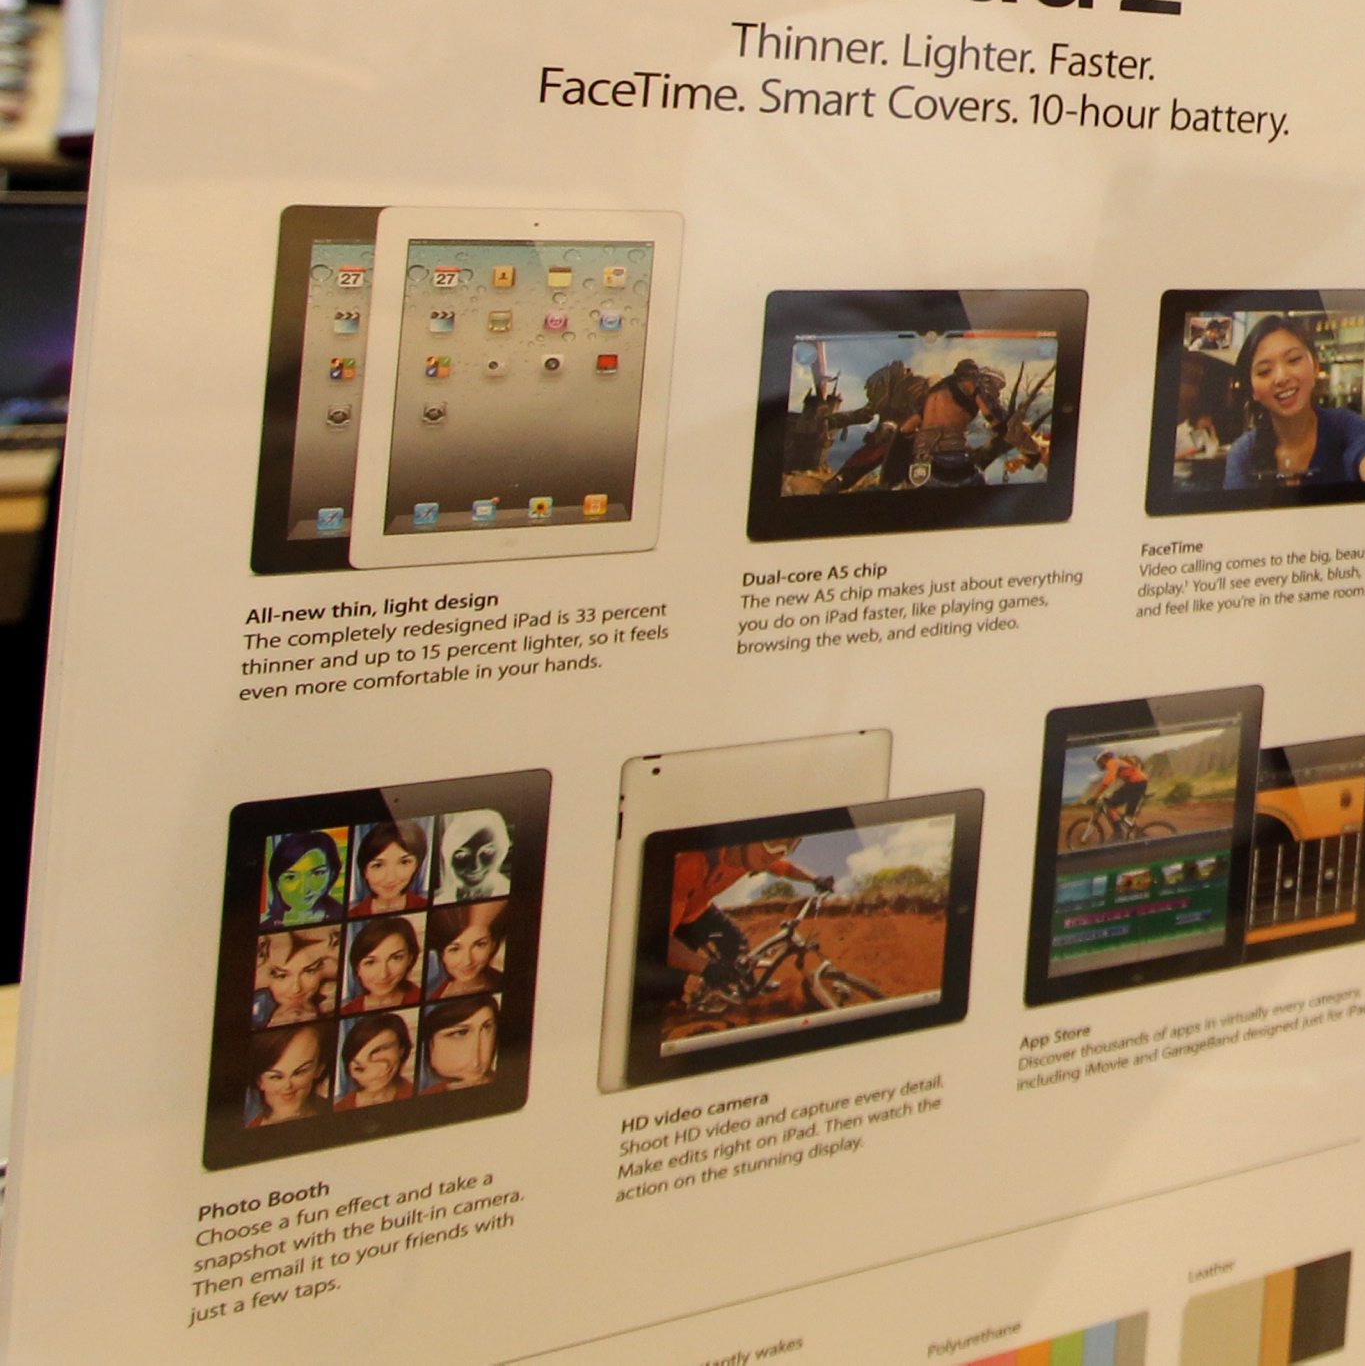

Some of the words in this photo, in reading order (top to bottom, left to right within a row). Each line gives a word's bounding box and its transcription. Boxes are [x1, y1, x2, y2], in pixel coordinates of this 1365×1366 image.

[731, 21, 888, 66] Thinner.
[903, 33, 1036, 79] Lighter.
[1049, 42, 1155, 81] Faster.
[539, 66, 745, 113] FaceTime.
[759, 78, 876, 118] Smart
[888, 85, 1018, 124] Covers.
[1029, 93, 1161, 130] 10-hour
[1170, 97, 1289, 144] battery.
[339, 272, 362, 286] 27
[435, 272, 457, 286] 27
[1139, 561, 1178, 578] Video
[1180, 558, 1223, 575] calling
[1225, 557, 1266, 571] comes
[1270, 555, 1284, 567] to
[1286, 551, 1307, 565] the
[1309, 549, 1332, 566] big,
[1140, 540, 1204, 557] FaceTime
[740, 593, 771, 610] The
[775, 593, 810, 607] new
[813, 588, 835, 603] A5
[839, 585, 874, 603] chip
[877, 581, 925, 599] makes
[928, 580, 956, 598] just
[960, 576, 1003, 592] about
[1007, 569, 1083, 589] everything
[742, 569, 823, 587] Dual-core
[827, 565, 849, 580] A5
[853, 562, 888, 580] chip
[1230, 577, 1251, 590] see
[1254, 574, 1289, 588] every
[1291, 568, 1323, 585] blink,
[1327, 565, 1362, 581] blush,
[245, 606, 326, 625] All-new
[331, 601, 377, 619] thin,
[383, 596, 429, 618] light
[434, 593, 499, 612] design
[738, 619, 769, 637] you
[773, 613, 796, 630] do
[799, 614, 820, 627] on
[825, 606, 859, 625] iPad
[862, 606, 907, 621] faster,
[911, 601, 937, 617] like
[940, 598, 995, 618] playing
[998, 596, 1048, 614] games,
[1135, 602, 1162, 618] and
[1165, 599, 1190, 616] feel
[1192, 598, 1214, 613] like
[1258, 593, 1271, 607] in
[1274, 591, 1295, 605] the
[1297, 590, 1330, 603] same
[243, 632, 282, 650] The
[287, 622, 397, 648] completely
[403, 613, 507, 638] redesigned
[513, 610, 552, 629] iPad
[557, 610, 570, 625] is
[575, 608, 596, 624] 33
[601, 603, 667, 625] percent
[736, 636, 812, 655] browsing
[816, 631, 842, 648] the
[846, 627, 883, 645] web,
[886, 623, 916, 641] and
[920, 621, 973, 638] editing
[976, 616, 1019, 632] video.
[241, 657, 315, 676] thinner
[320, 649, 358, 669] and
[365, 651, 391, 668] up
[396, 648, 416, 663] to
[422, 643, 441, 660] 15
[447, 639, 517, 662] percent
[523, 633, 583, 655] lighter,
[589, 633, 609, 646] so
[614, 628, 625, 644] it
[630, 624, 669, 642] feels
[239, 685, 288, 702] even
[295, 679, 348, 696] more
[353, 665, 470, 691] comfortable
[475, 664, 492, 680] in
[498, 662, 539, 682] your
[544, 653, 602, 673] hands.
[619, 1134, 669, 1158] Shoot
[674, 1126, 702, 1145] HD
[705, 1117, 752, 1138] video
[755, 1106, 788, 1128] and
[790, 1097, 850, 1120] capture
[854, 1087, 896, 1106] every
[621, 1115, 649, 1135] HD
[654, 1107, 703, 1127] video
[707, 1093, 769, 1116] camera
[617, 1158, 663, 1180] Make
[667, 1149, 708, 1169] edits
[713, 1138, 752, 1161] right
[756, 1134, 778, 1150] on
[824, 1116, 863, 1134] Then
[867, 1102, 913, 1124] watch
[917, 1098, 941, 1114] the
[615, 1180, 669, 1203] action
[673, 1174, 696, 1190] on
[700, 1166, 728, 1184] the
[733, 1150, 804, 1177] stunning
[195, 1220, 273, 1247] Choose
[278, 1217, 290, 1230] a
[296, 1208, 329, 1227] fun
[335, 1193, 390, 1218] effect
[395, 1181, 433, 1205] and
[438, 1175, 478, 1196] take
[482, 1173, 493, 1186] a
[198, 1198, 261, 1223] Photo
[267, 1181, 330, 1208] Booth
[194, 1240, 287, 1273] snapshot
[292, 1227, 336, 1251] with
[342, 1222, 375, 1240] the
[380, 1205, 447, 1232] built-in
[453, 1190, 524, 1216] camera.
[192, 1275, 244, 1297] Then
[250, 1257, 305, 1285] email
[311, 1255, 324, 1272] it
[330, 1251, 351, 1267] to
[356, 1240, 400, 1266] your
[405, 1222, 469, 1251] friends
[474, 1211, 515, 1234] with
[187, 1302, 227, 1328] just
[233, 1299, 245, 1314] a
[252, 1289, 289, 1309] few
[294, 1278, 341, 1299] taps.
[755, 1337, 804, 1361] wakes
